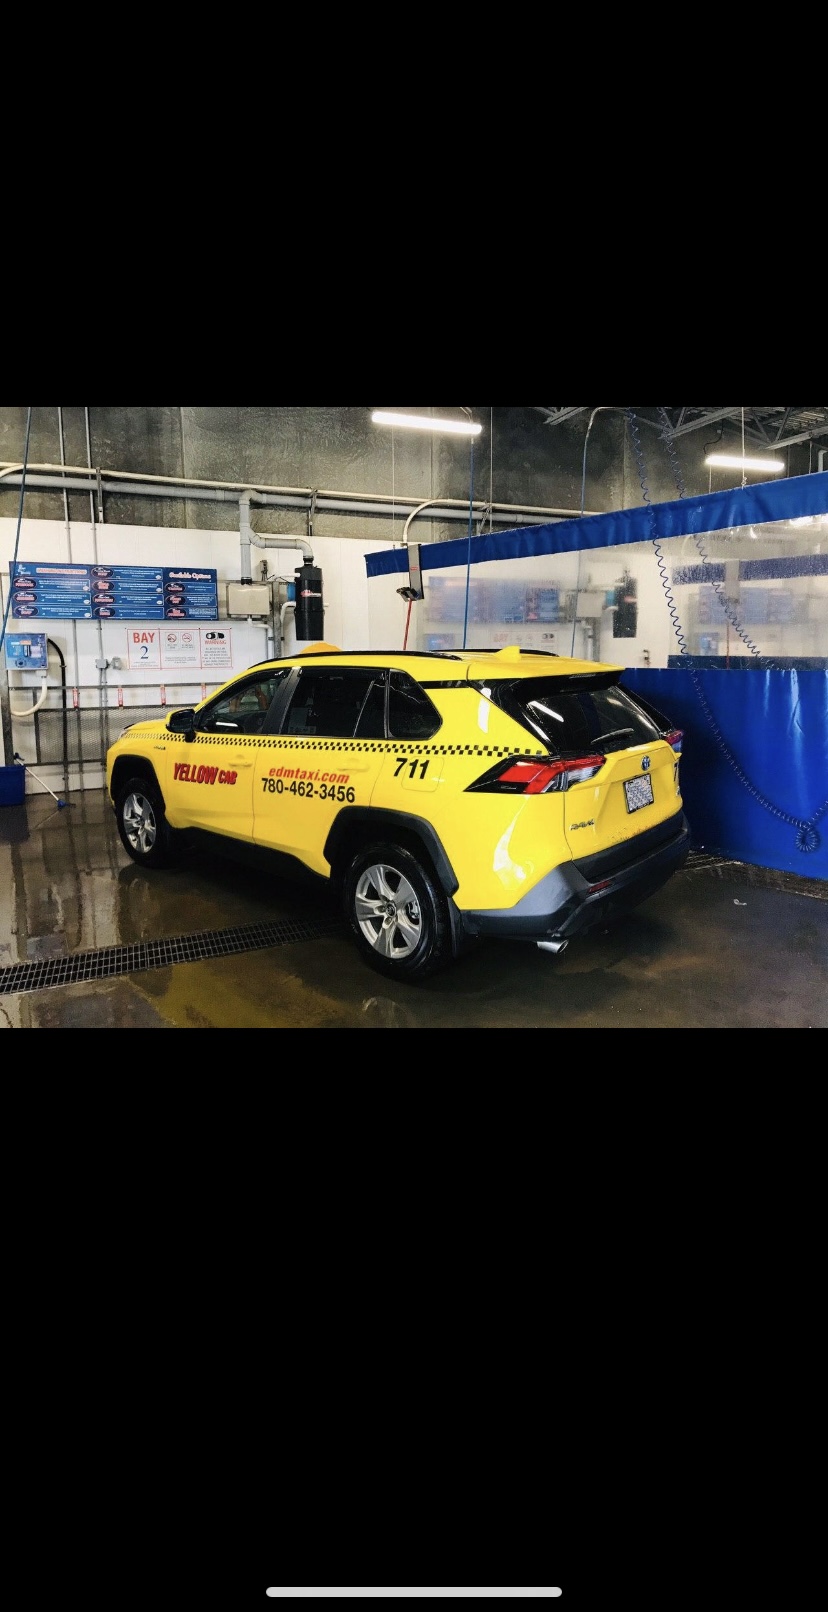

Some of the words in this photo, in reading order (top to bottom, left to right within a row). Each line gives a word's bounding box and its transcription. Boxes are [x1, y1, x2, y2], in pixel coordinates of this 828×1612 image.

[133, 632, 155, 643] BAY
[140, 646, 149, 659] 2
[173, 762, 219, 785] YELLOW
[218, 770, 238, 785] CAB
[268, 766, 350, 784] edmtaxi.com
[393, 757, 430, 780] 711
[261, 777, 355, 803] 780-462-3456
